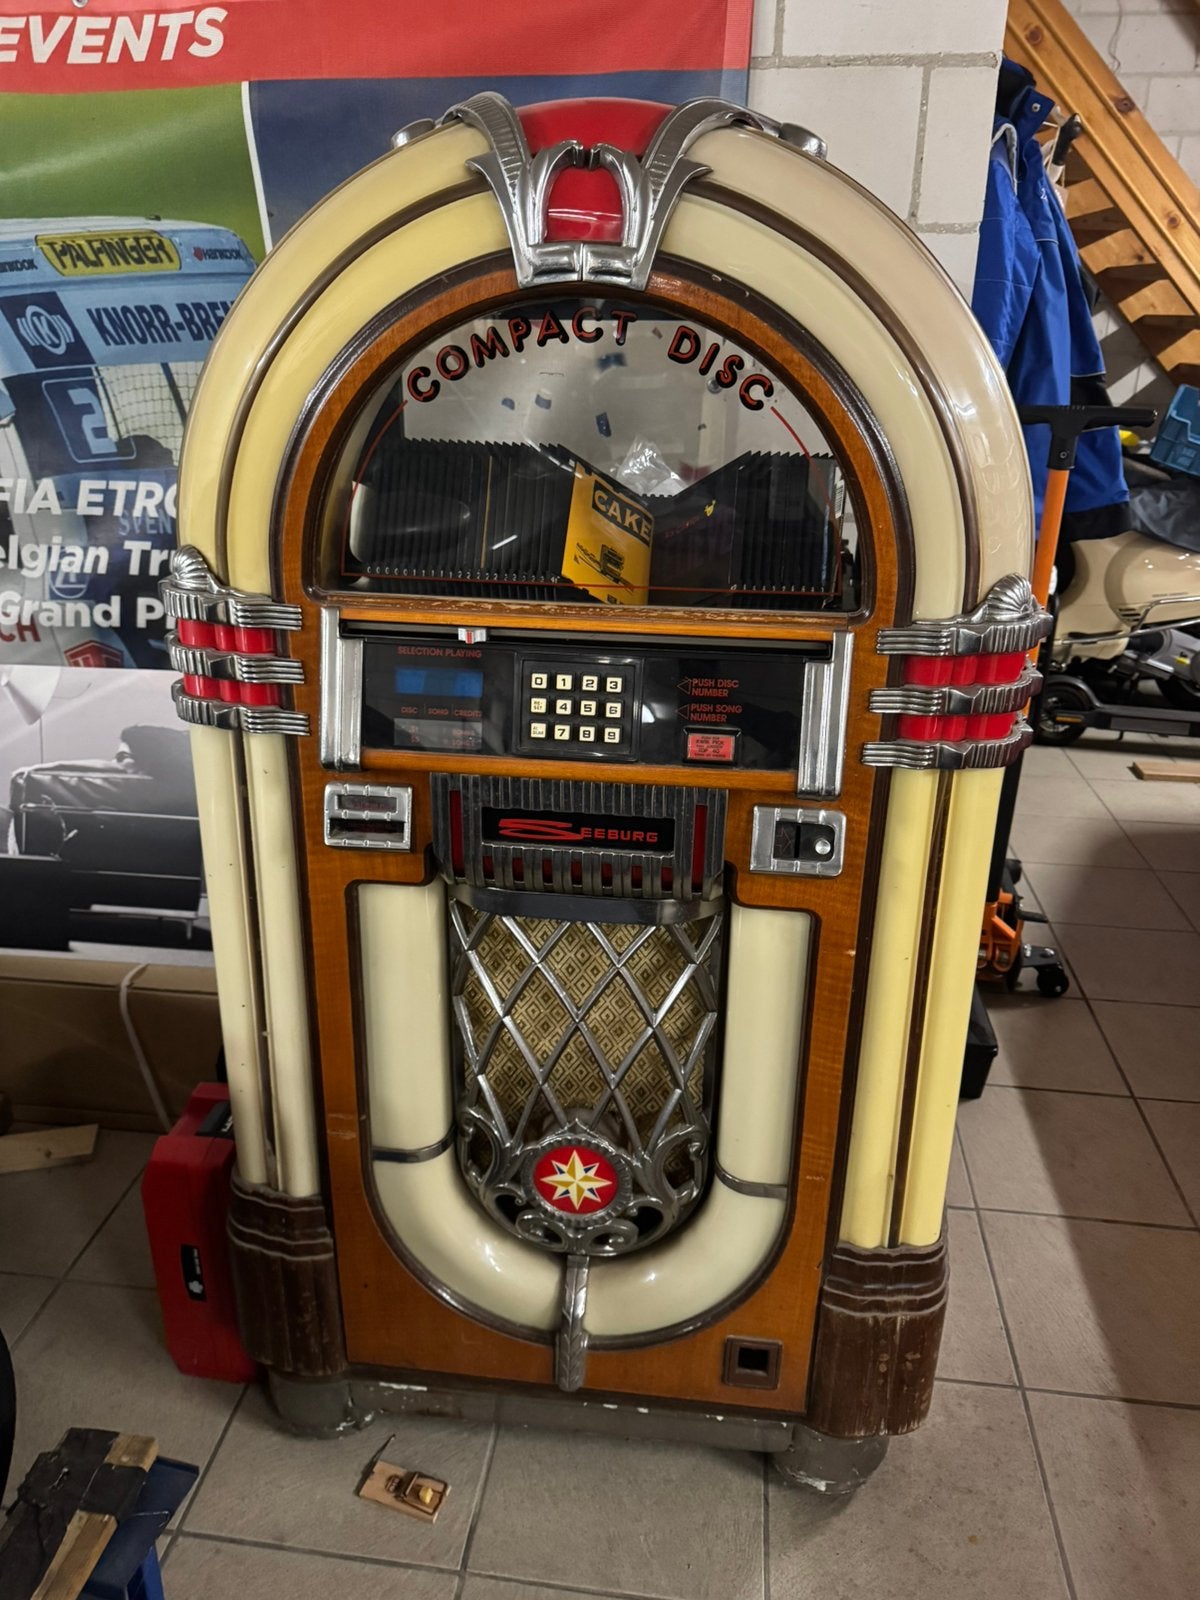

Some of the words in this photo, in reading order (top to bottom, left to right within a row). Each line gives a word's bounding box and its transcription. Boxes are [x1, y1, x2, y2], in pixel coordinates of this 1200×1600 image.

[48, 235, 175, 270] PALFINGER
[86, 299, 236, 346] KNORR-BRE
[406, 306, 638, 403] COMPACT
[667, 325, 775, 412] DISC
[66, 387, 118, 455] 2
[594, 489, 651, 541] CAKE
[123, 540, 175, 577] Tr
[0, 591, 122, 628] Grand
[136, 597, 176, 630] P
[397, 646, 442, 657] SELECTION
[445, 648, 482, 659] PLAYING
[535, 677, 543, 686] 0
[561, 678, 566, 687] 1
[585, 679, 595, 688] 2
[609, 680, 618, 690] 3
[691, 679, 715, 688] PUSH
[717, 679, 740, 688] DISC
[691, 688, 729, 698] NUMBER
[559, 703, 567, 711] 4
[583, 704, 592, 713] 5
[690, 704, 715, 713] PUSH
[716, 704, 742, 714] SONG
[690, 713, 728, 723] NUMBER
[557, 728, 566, 737] 7
[582, 729, 591, 739] 8
[607, 731, 616, 740] 9
[499, 818, 658, 842] SEEBURG
